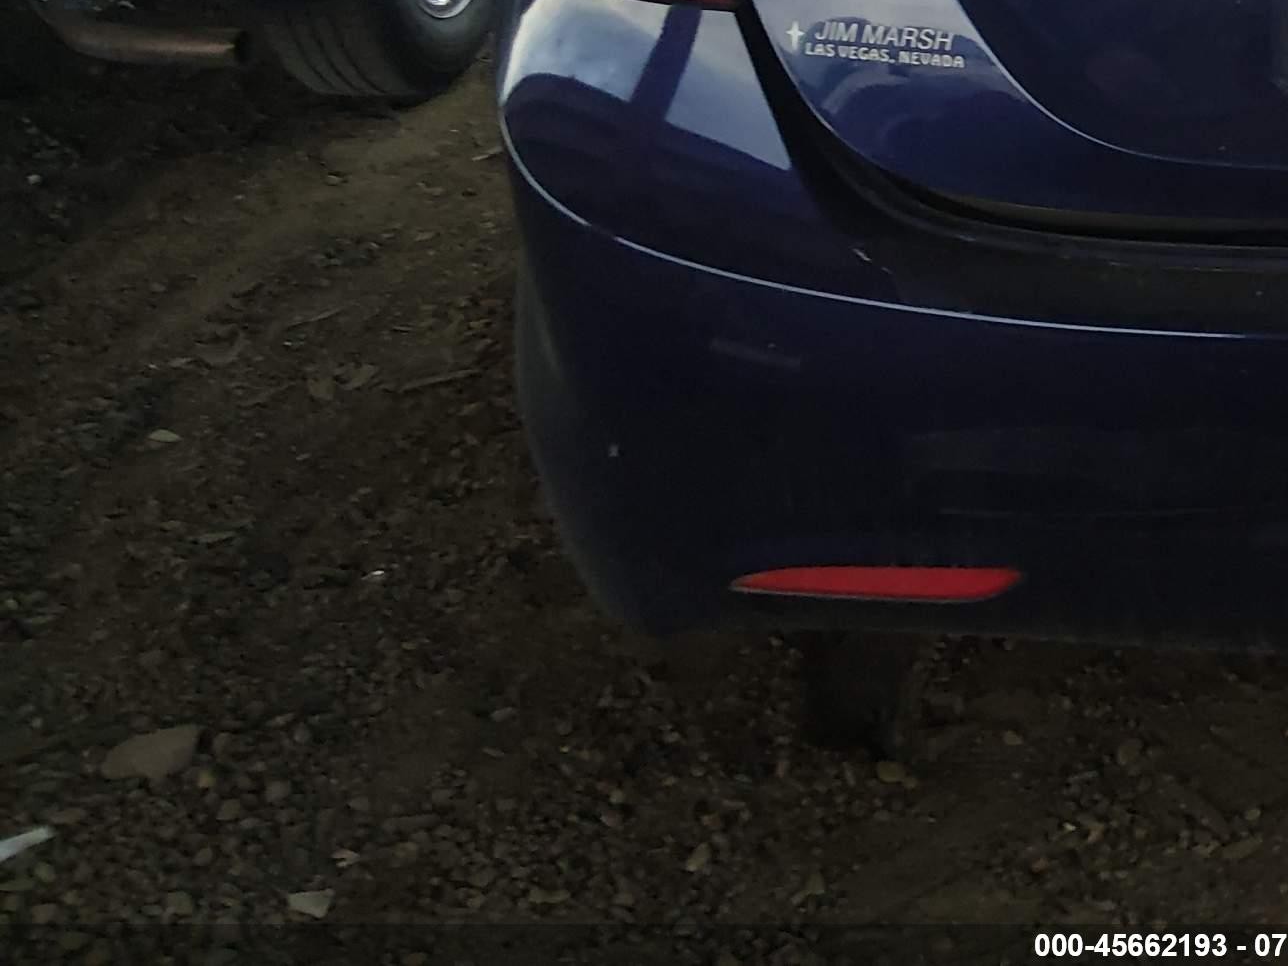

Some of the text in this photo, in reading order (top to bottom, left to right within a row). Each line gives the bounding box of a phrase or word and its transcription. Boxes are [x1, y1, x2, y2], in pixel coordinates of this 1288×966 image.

[815, 21, 953, 51] JIM MARSH
[805, 43, 835, 57] LAS
[899, 51, 964, 68] NEVADA
